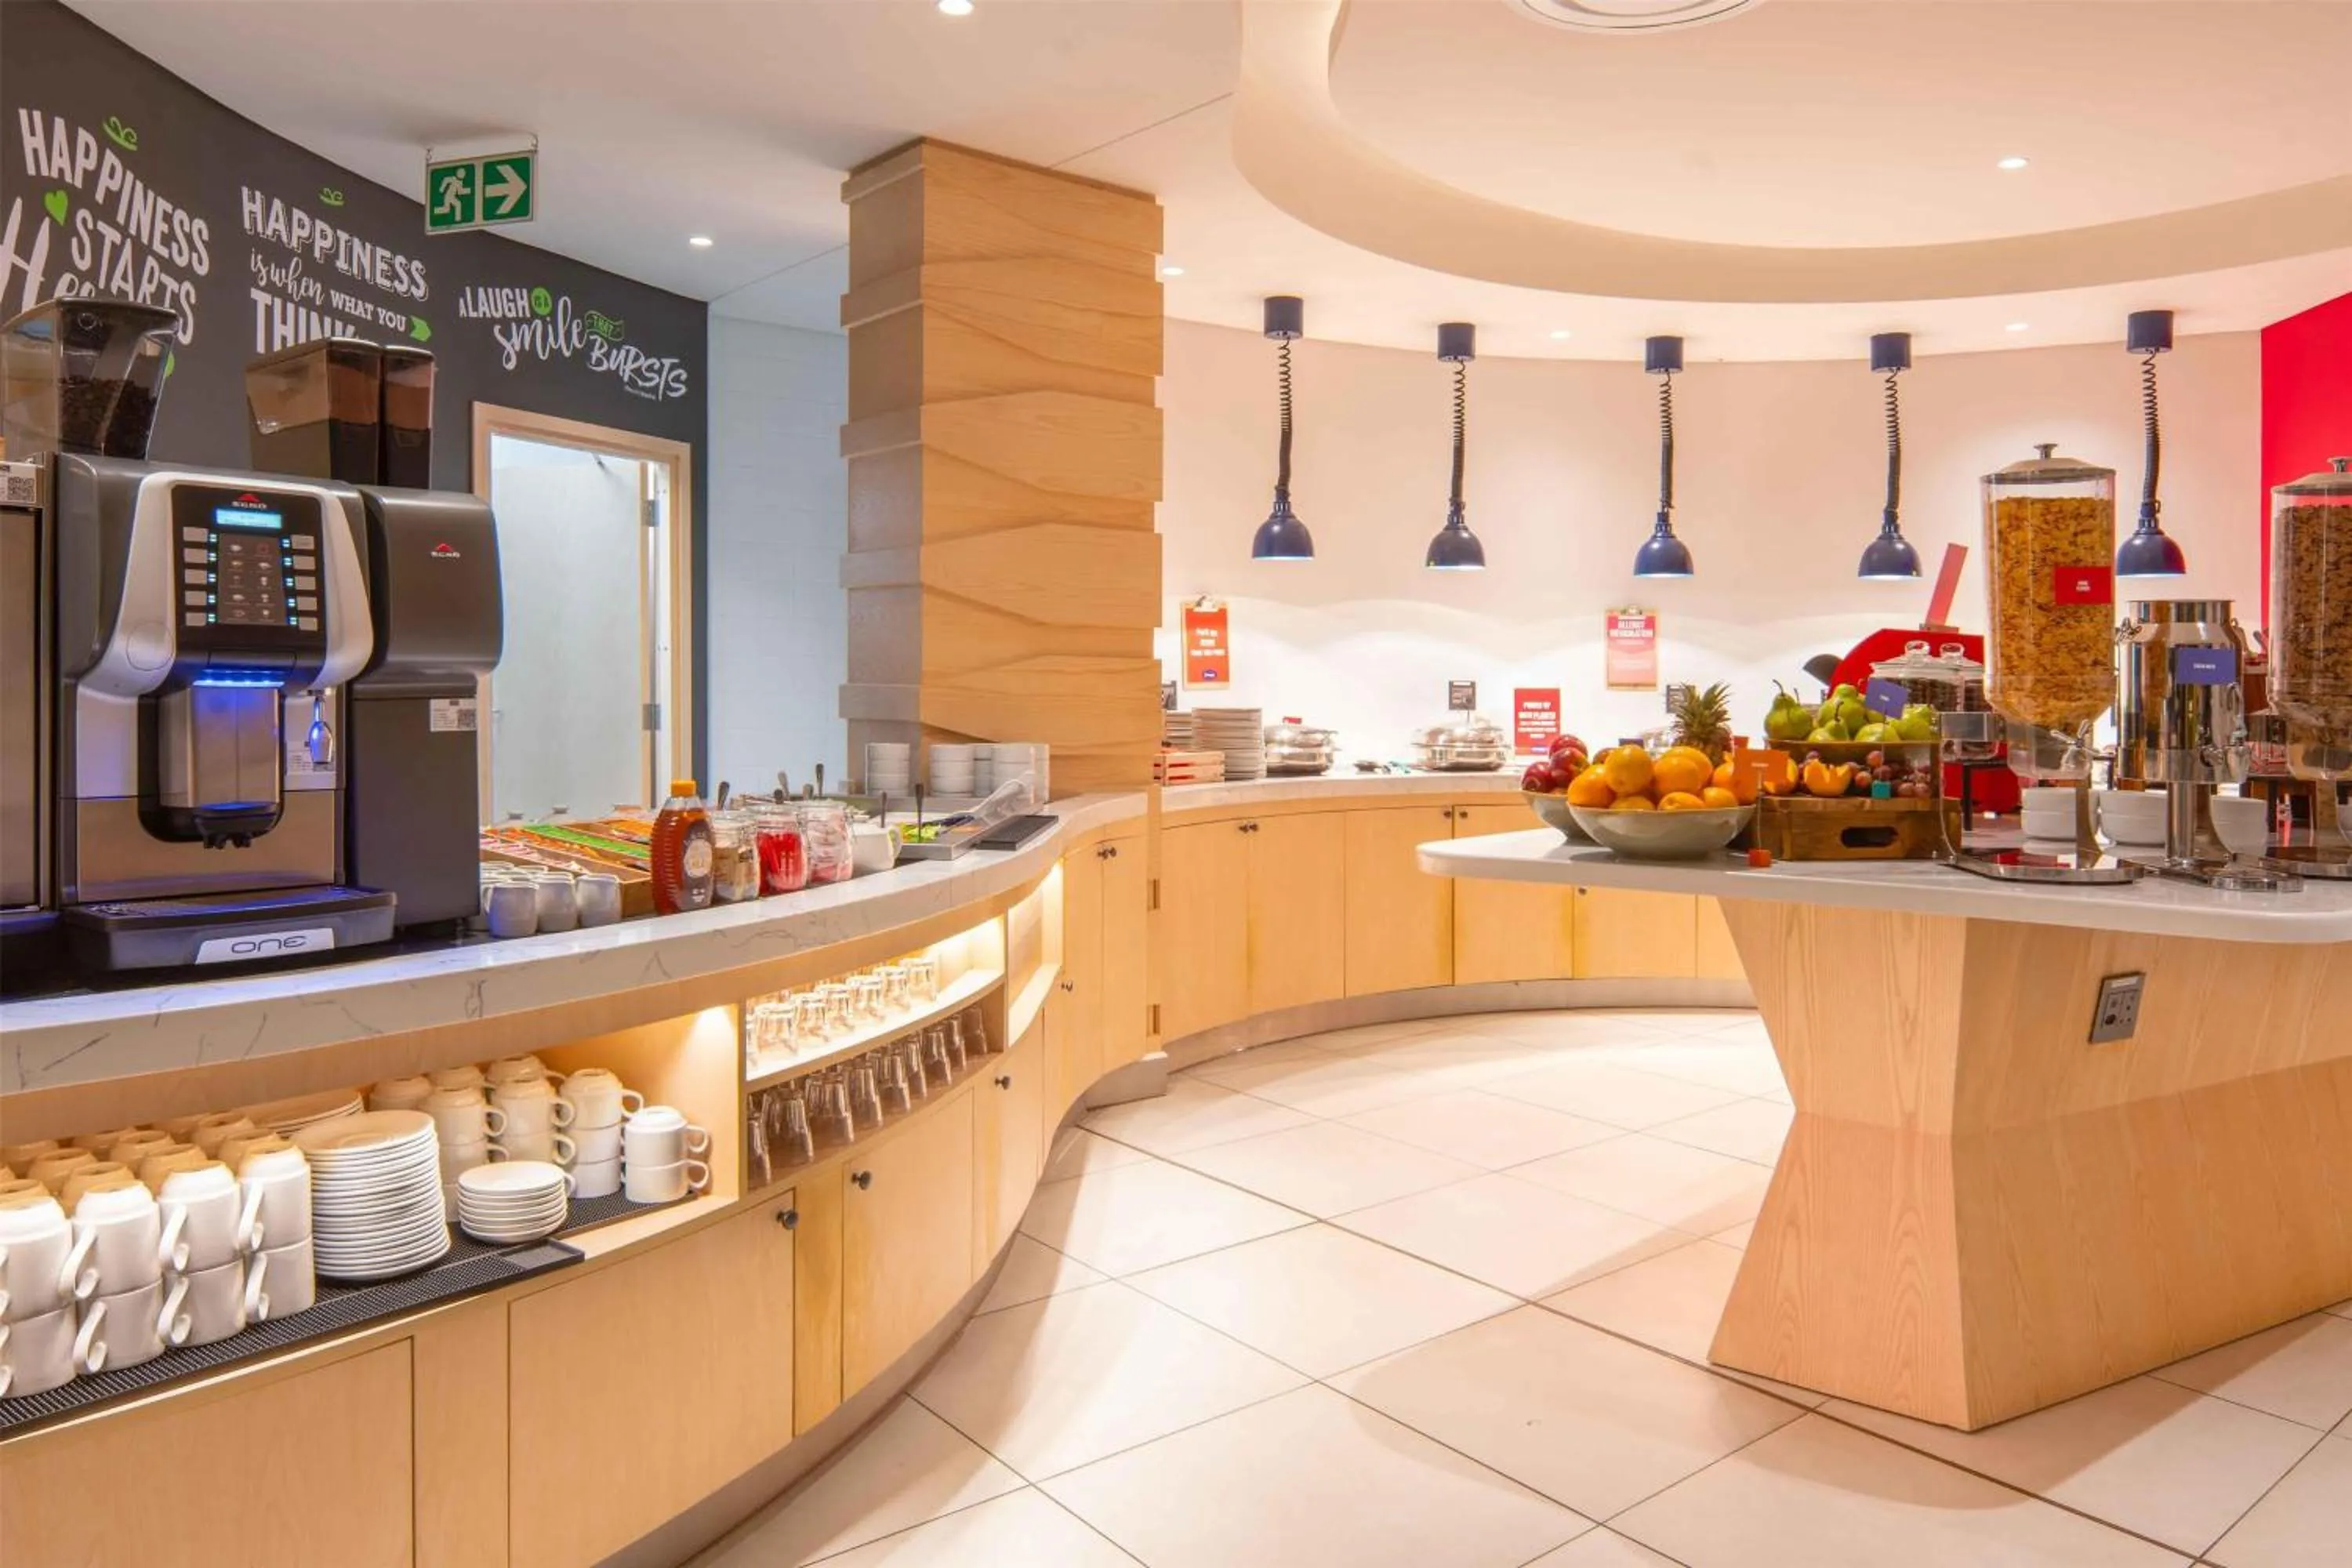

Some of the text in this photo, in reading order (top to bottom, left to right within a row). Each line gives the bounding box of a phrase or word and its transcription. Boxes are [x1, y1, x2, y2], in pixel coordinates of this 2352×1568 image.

[18, 107, 210, 276] HAPPINESS
[241, 186, 429, 302] HAPPINESS
[251, 248, 325, 306] is when
[330, 289, 406, 332] WHAT YOU
[465, 286, 531, 318] LAUGH
[493, 296, 586, 370] smile
